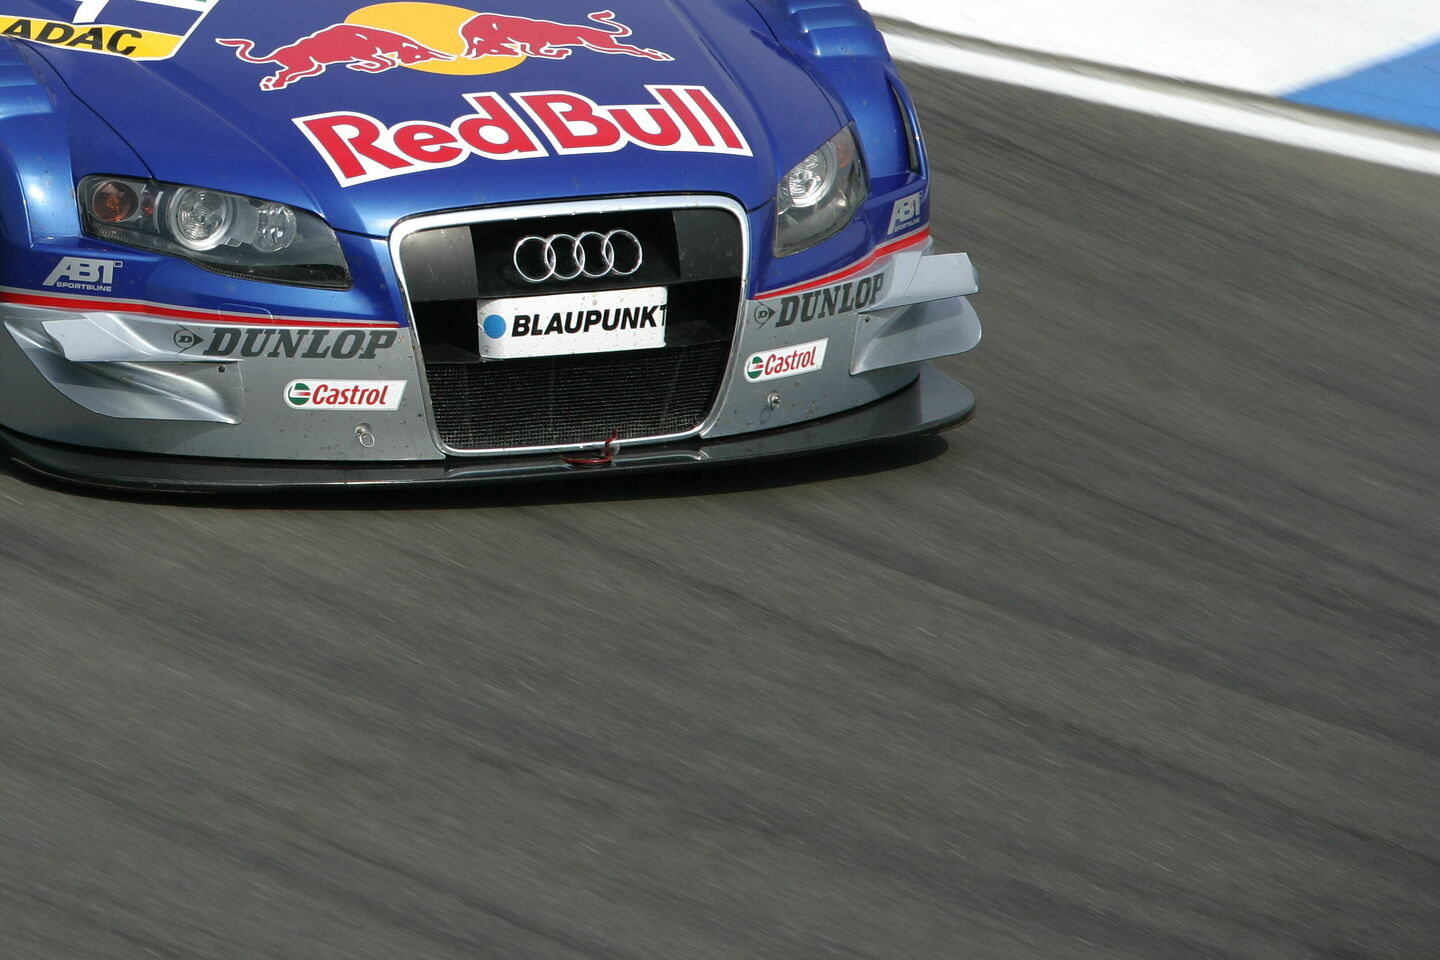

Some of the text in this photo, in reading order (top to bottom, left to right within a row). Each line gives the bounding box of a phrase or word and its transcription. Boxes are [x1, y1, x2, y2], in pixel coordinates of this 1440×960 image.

[3, 18, 142, 56] ADAC
[887, 191, 921, 235] ABT
[42, 256, 115, 286] ABT
[56, 281, 112, 292] SPORTSLINE
[775, 272, 885, 328] DUNLOP
[203, 327, 398, 359] DUNLOP
[764, 346, 817, 376] Castrol
[312, 384, 389, 406] Castrol
